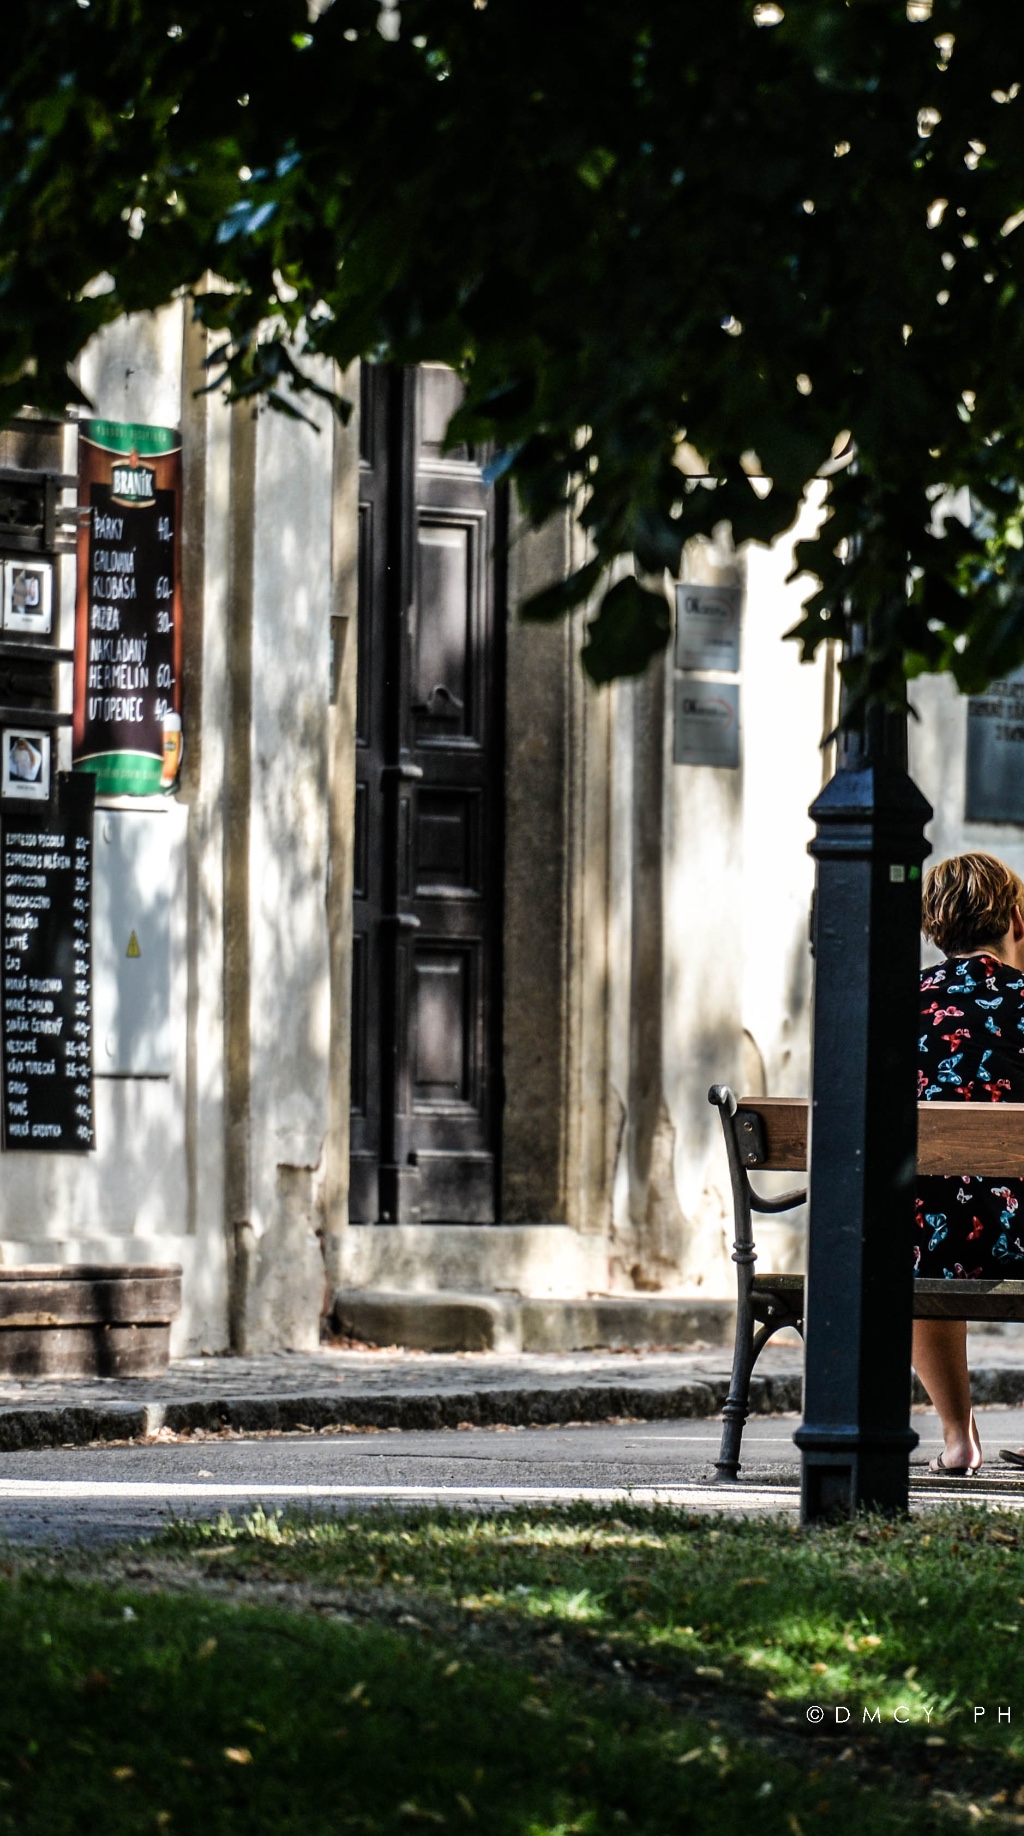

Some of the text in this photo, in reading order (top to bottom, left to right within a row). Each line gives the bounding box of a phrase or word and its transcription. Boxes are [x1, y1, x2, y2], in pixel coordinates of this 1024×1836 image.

[113, 468, 153, 497] BRANÍK
[94, 513, 123, 540] PÁRKY
[93, 573, 137, 600] KLOBÁSA
[91, 604, 120, 631] PIZZA
[90, 632, 148, 663] NAKLÁDANÝ
[89, 662, 149, 690] HERMELÍN
[89, 696, 144, 722] UTOPENEC
